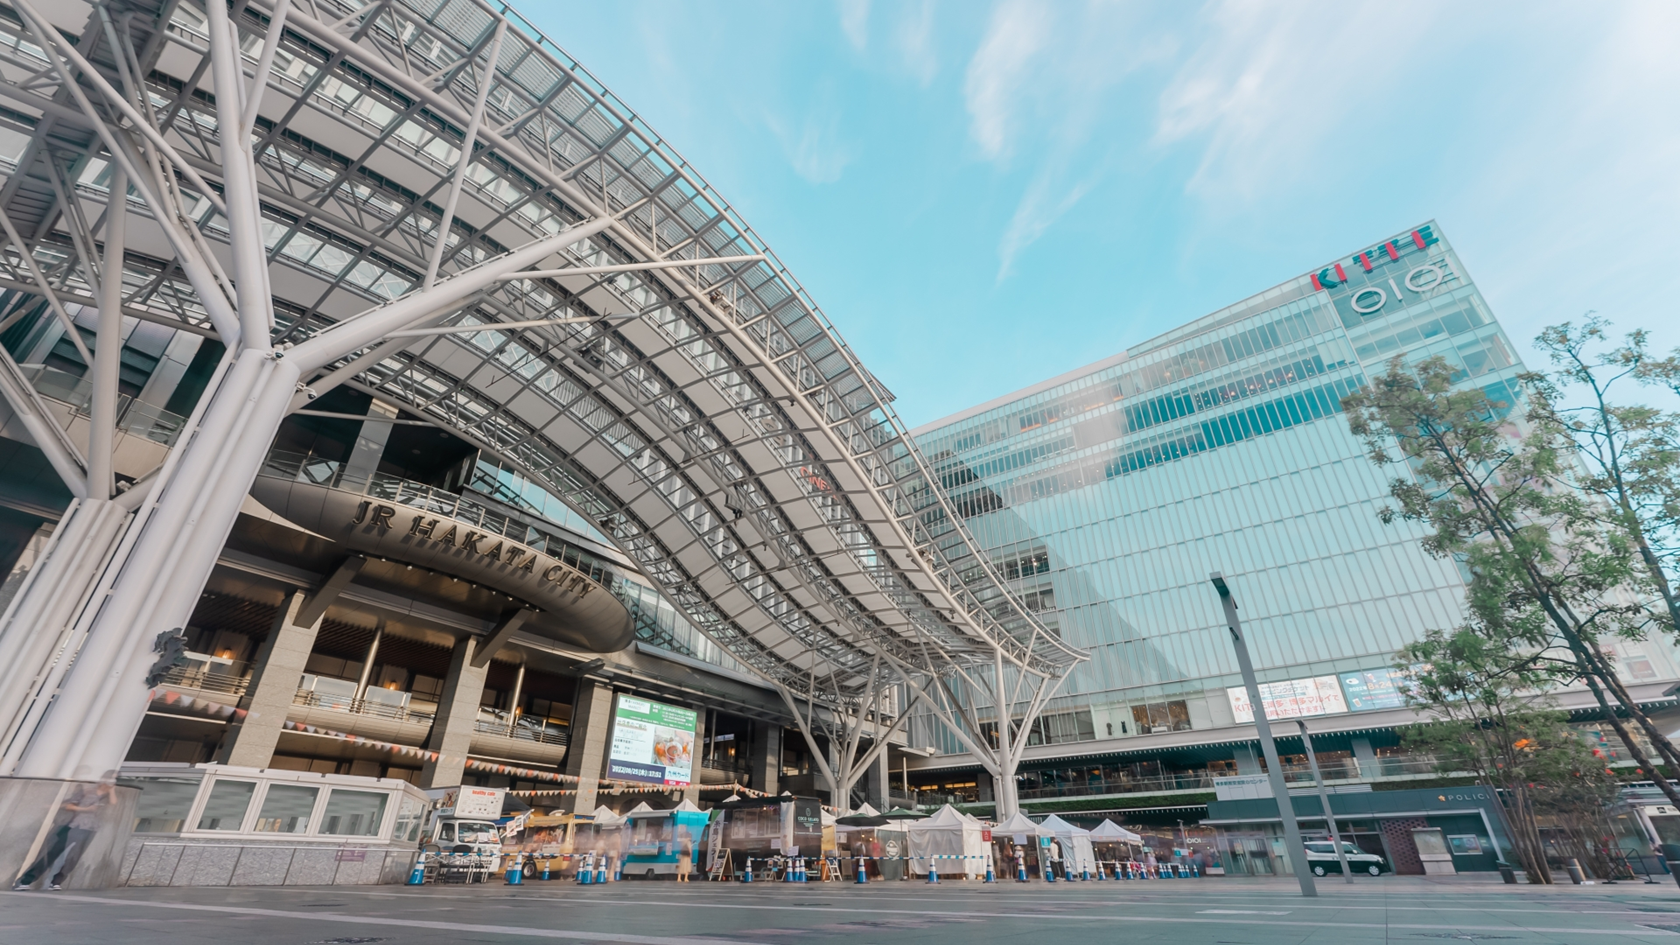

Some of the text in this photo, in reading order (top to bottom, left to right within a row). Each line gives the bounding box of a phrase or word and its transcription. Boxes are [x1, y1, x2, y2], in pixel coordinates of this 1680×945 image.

[1310, 225, 1440, 291] KITTE
[352, 500, 598, 600] JR HAKATA CITY
